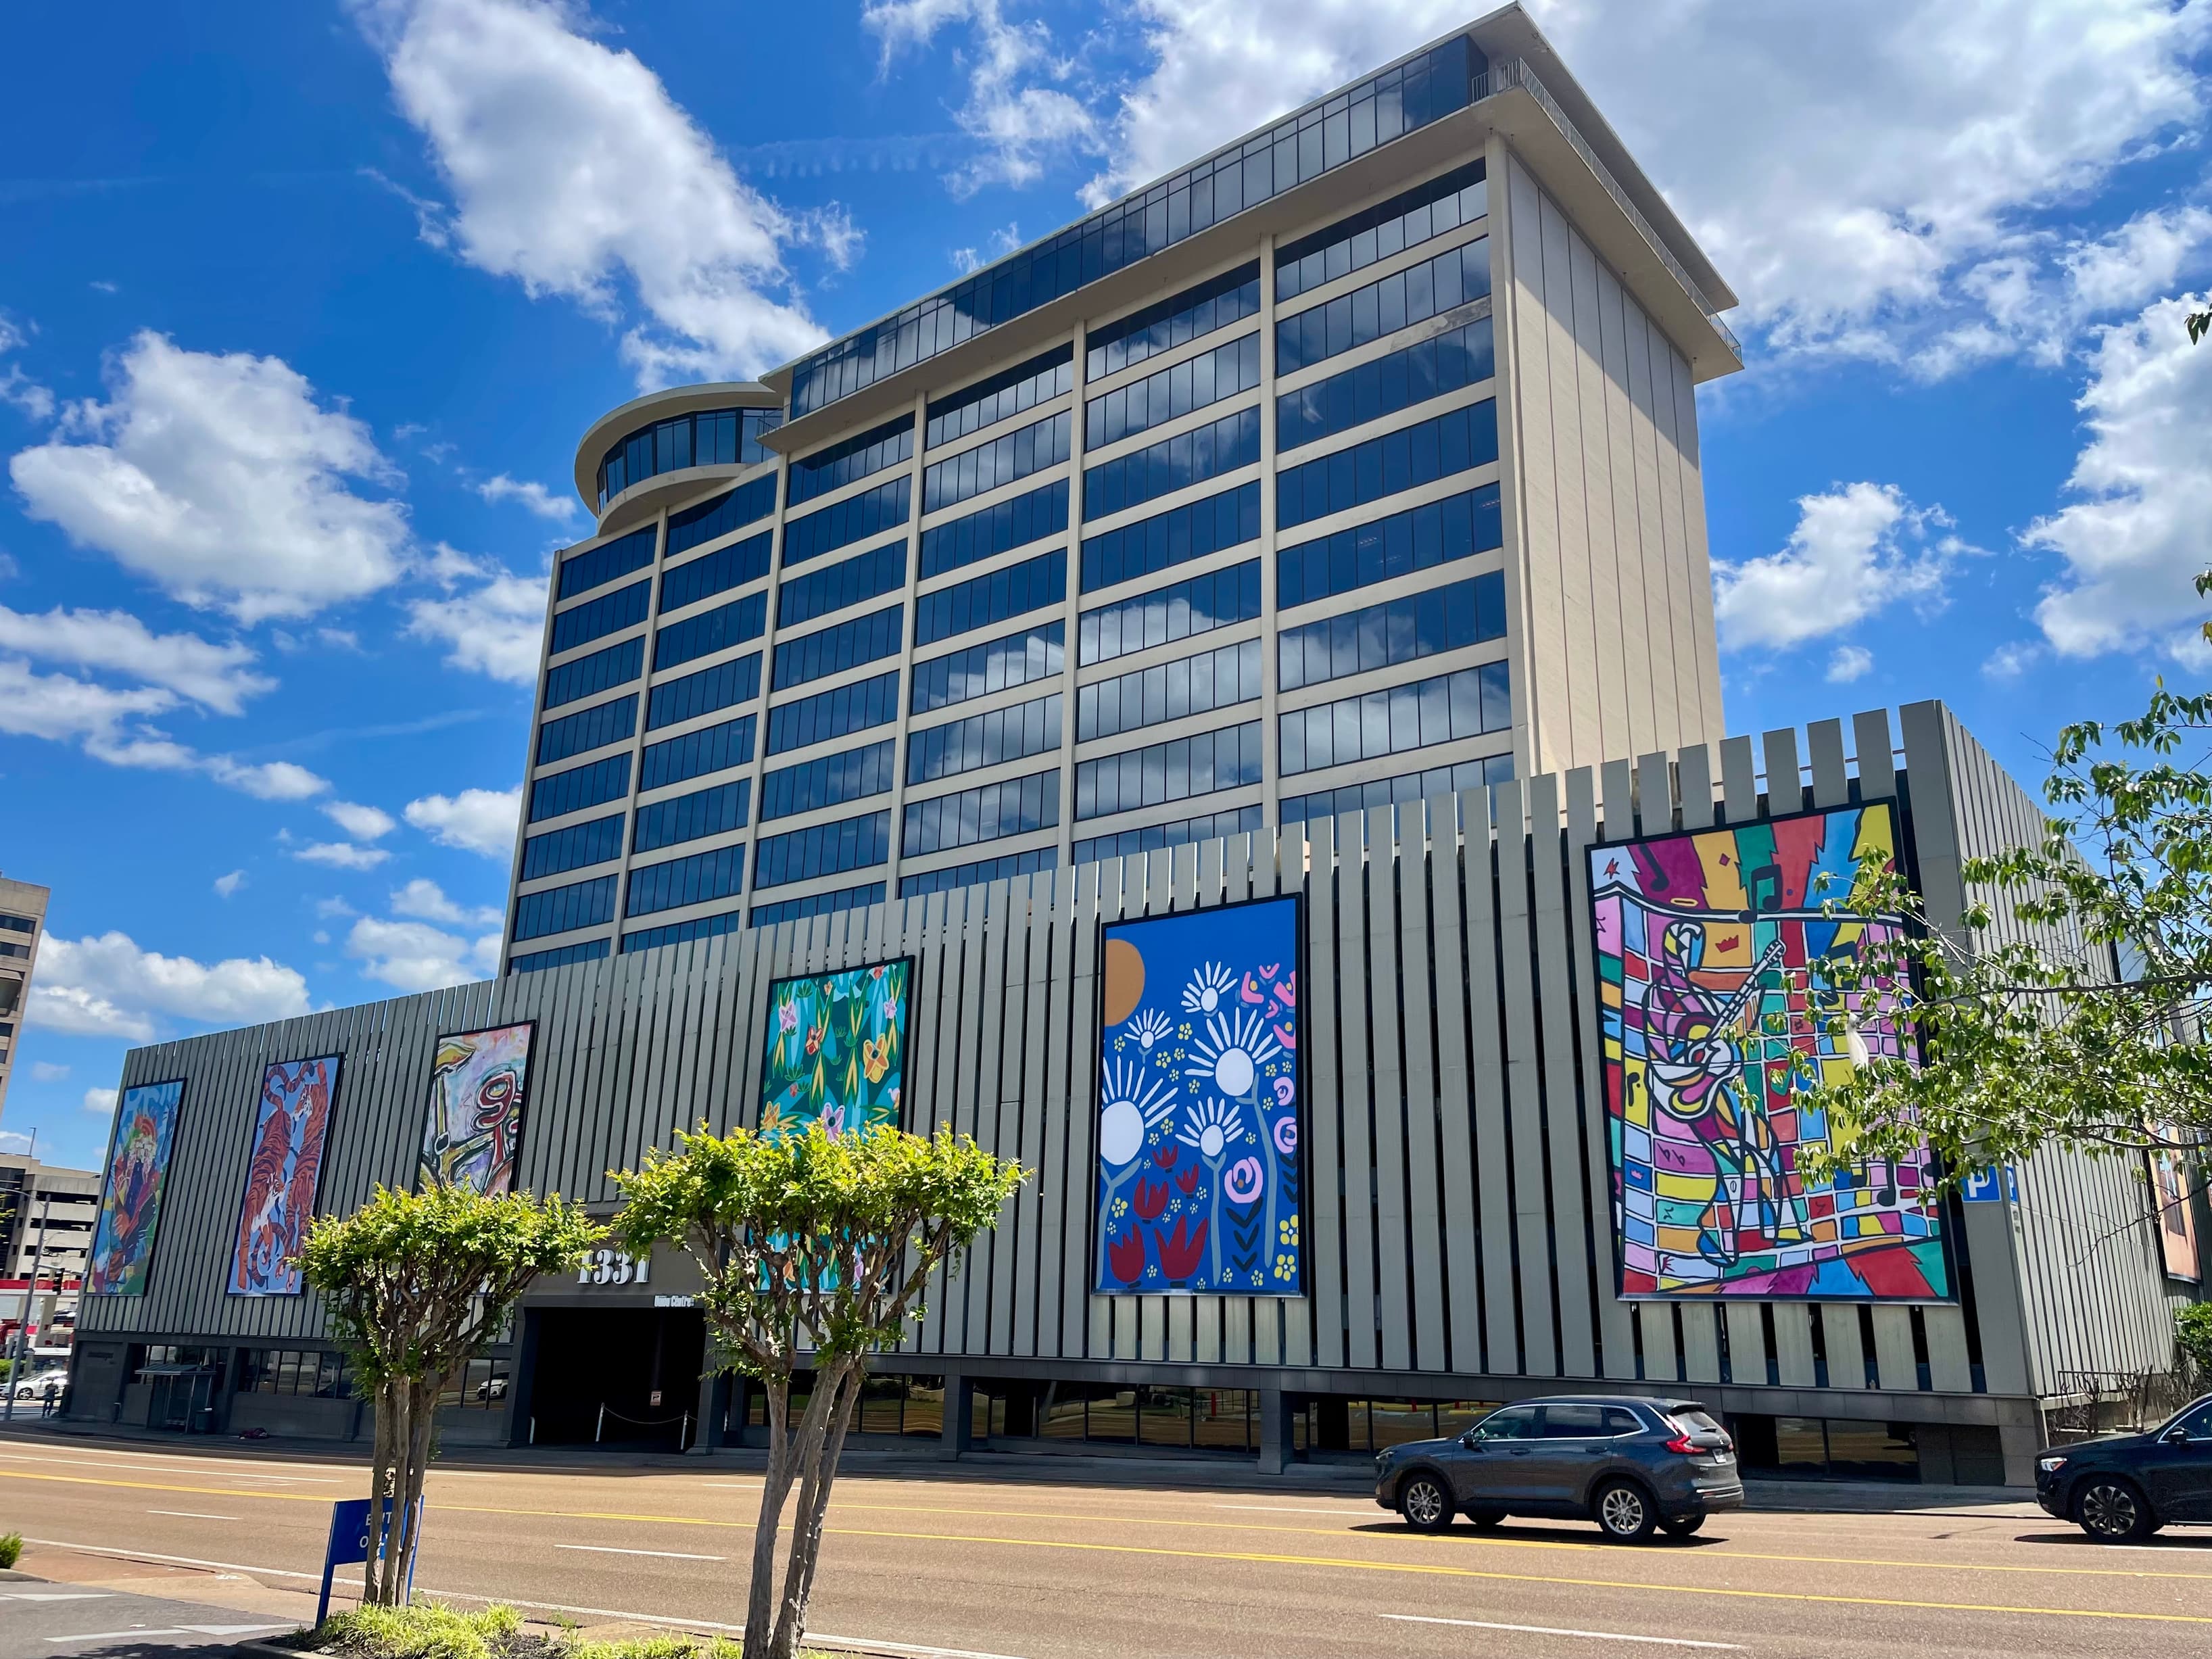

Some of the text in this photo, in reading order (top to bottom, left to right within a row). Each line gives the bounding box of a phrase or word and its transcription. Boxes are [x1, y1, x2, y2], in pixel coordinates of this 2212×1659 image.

[1967, 1170, 1990, 1198] P
[2006, 1170, 2015, 1197] P
[577, 1249, 651, 1285] 1331
[365, 1512, 392, 1526] EIT
